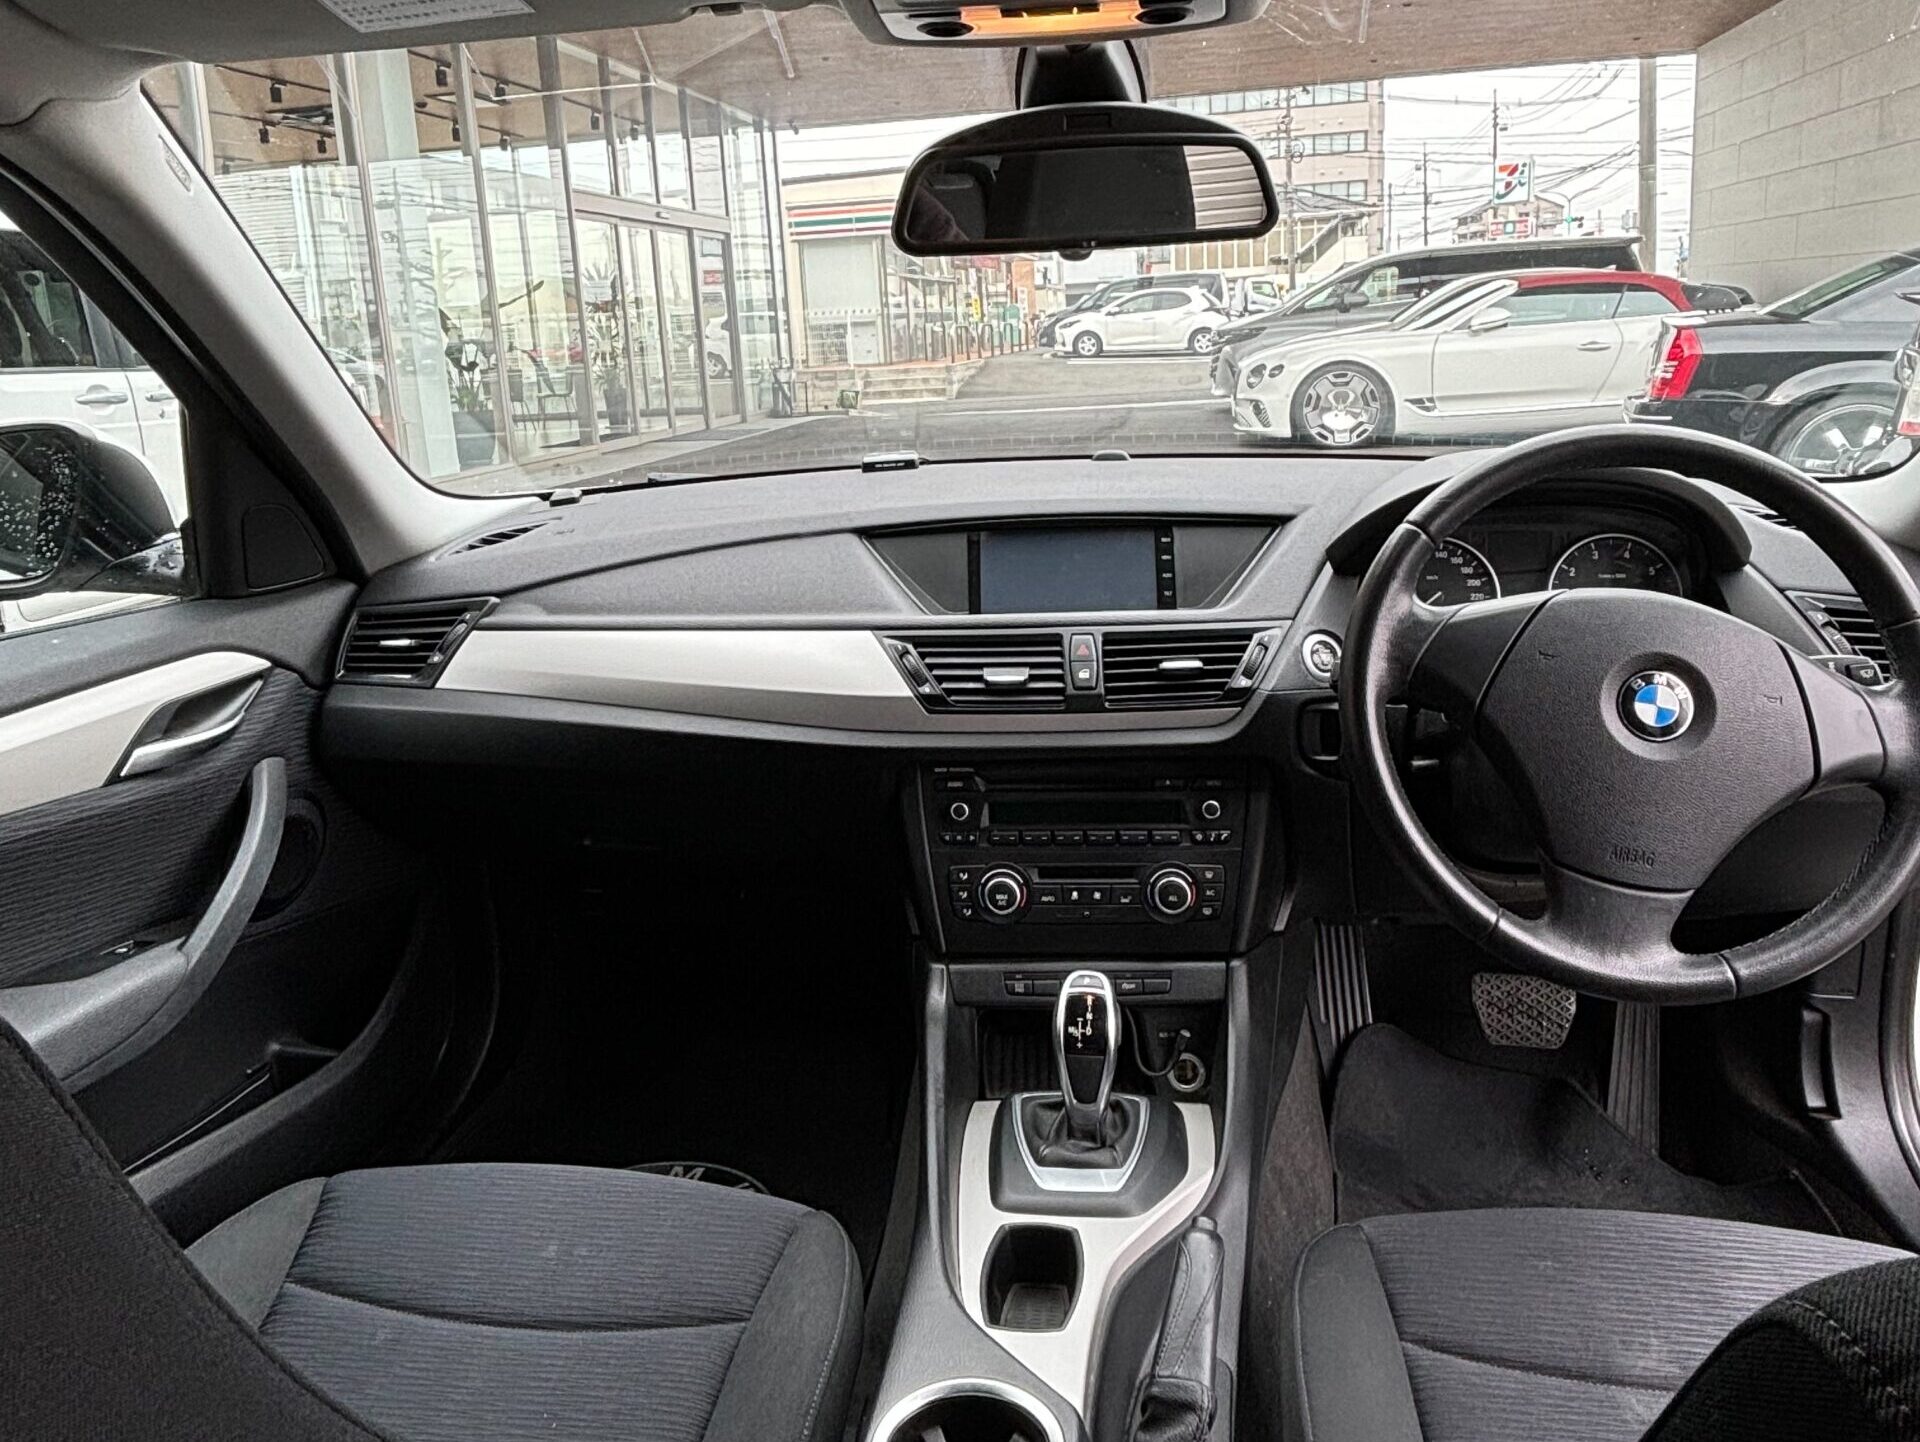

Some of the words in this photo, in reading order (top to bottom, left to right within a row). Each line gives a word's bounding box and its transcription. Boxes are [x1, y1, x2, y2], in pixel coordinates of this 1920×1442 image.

[1592, 550, 1599, 560] 3
[1623, 550, 1631, 559] 4
[1450, 556, 1464, 564] 160
[1460, 566, 1474, 574] 180
[1568, 567, 1576, 577] 2
[1648, 566, 1656, 576] 5
[1466, 579, 1481, 587] 200
[1470, 593, 1485, 601] 220
[1630, 673, 1689, 700] BMW
[1609, 844, 1657, 867] AIRBAG
[1085, 1026, 1093, 1036] D
